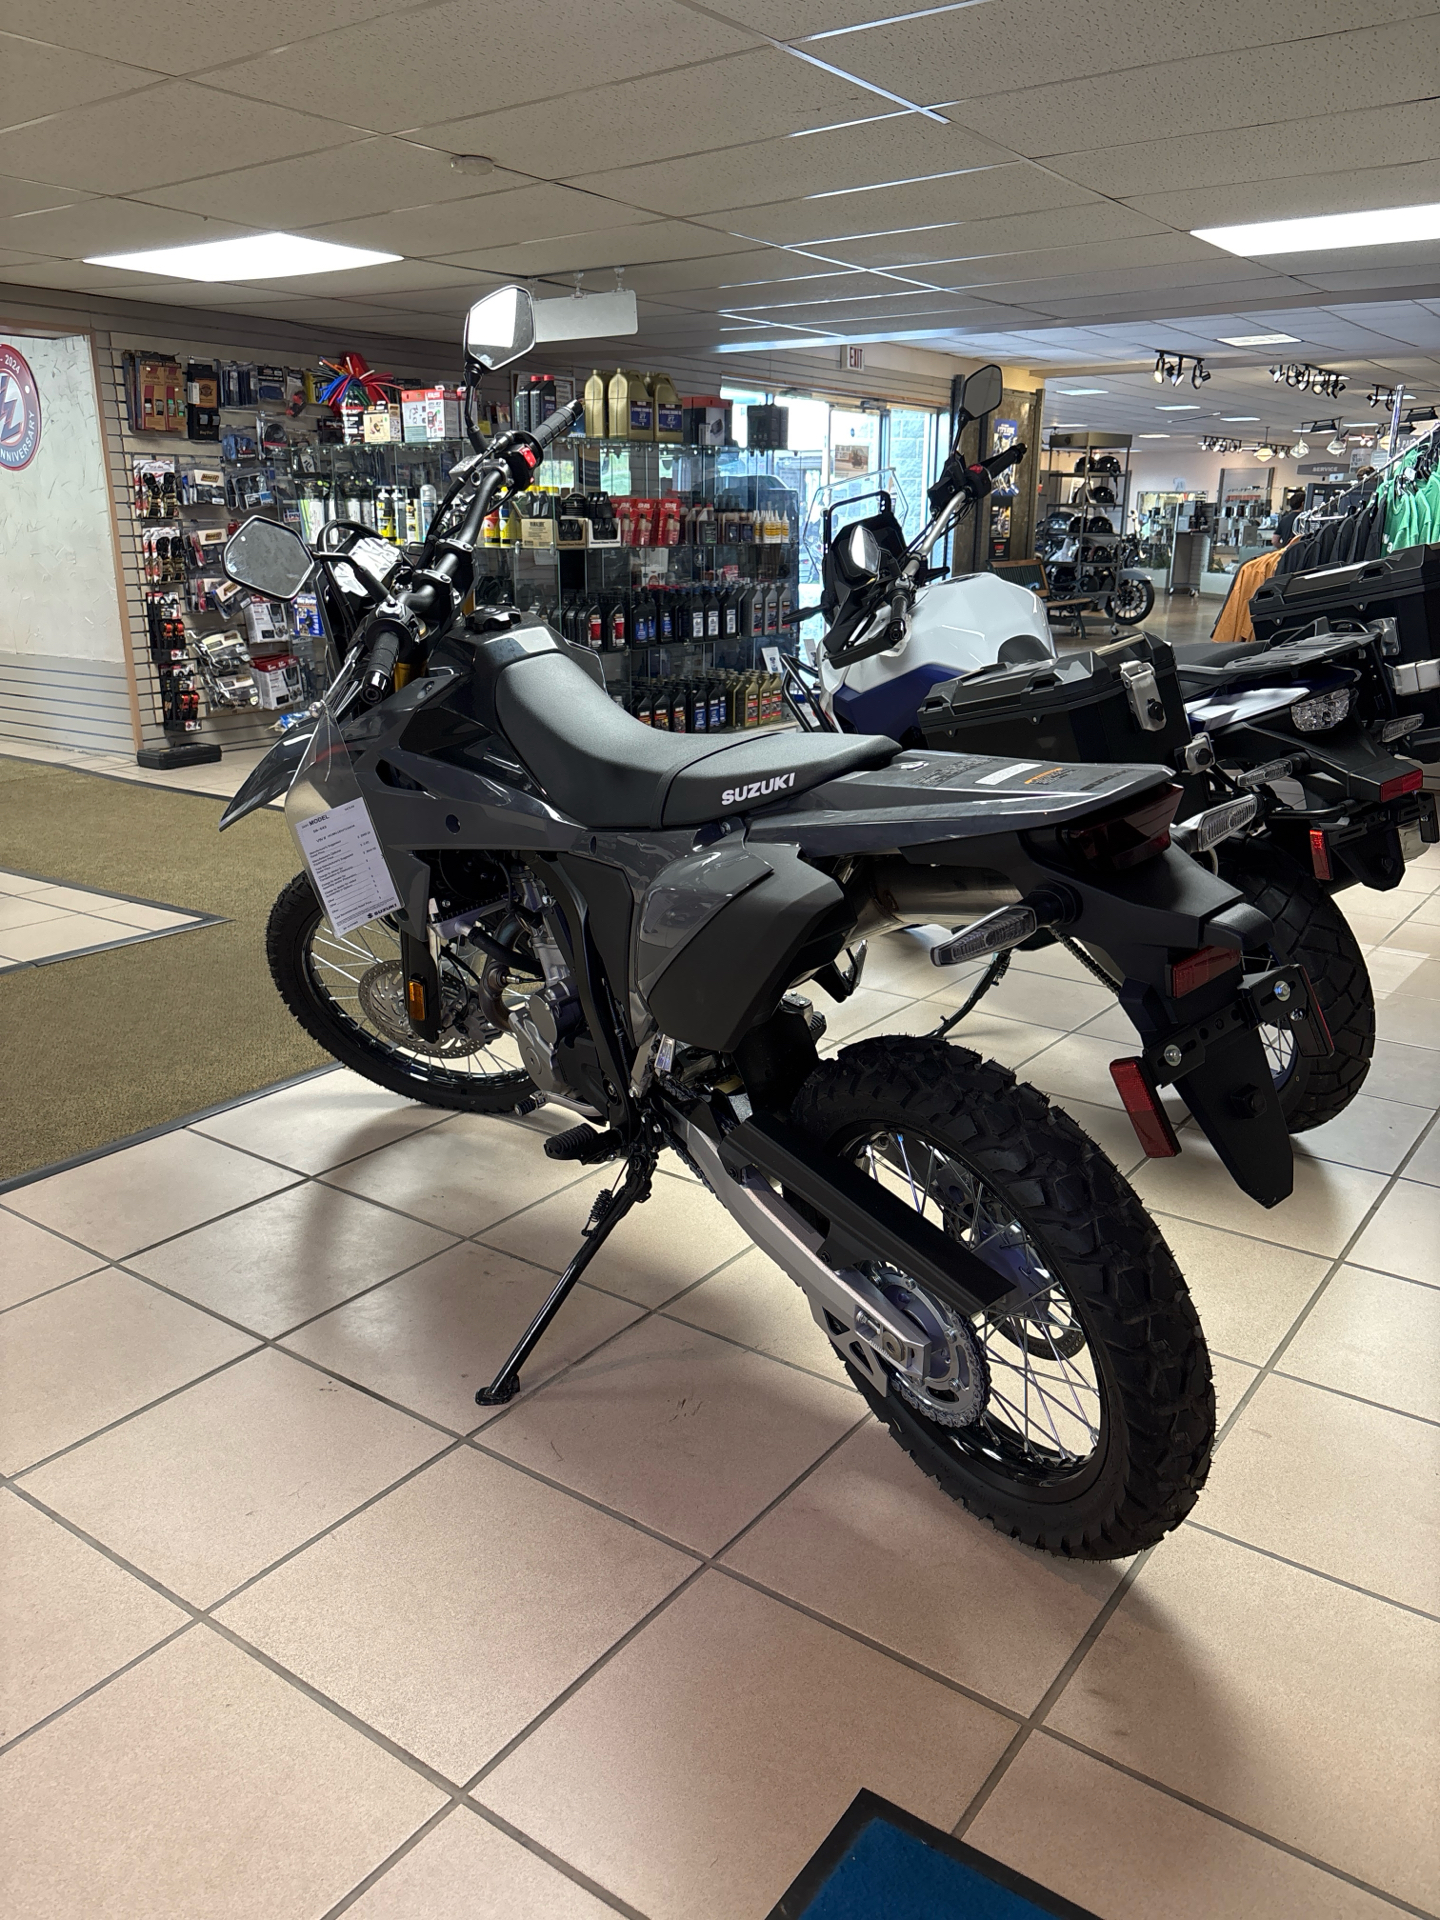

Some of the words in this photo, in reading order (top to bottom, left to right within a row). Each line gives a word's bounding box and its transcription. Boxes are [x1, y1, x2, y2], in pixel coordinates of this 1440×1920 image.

[5, 354, 21, 374] 2024
[849, 347, 863, 369] EXIT
[720, 772, 796, 807] SUZUKI
